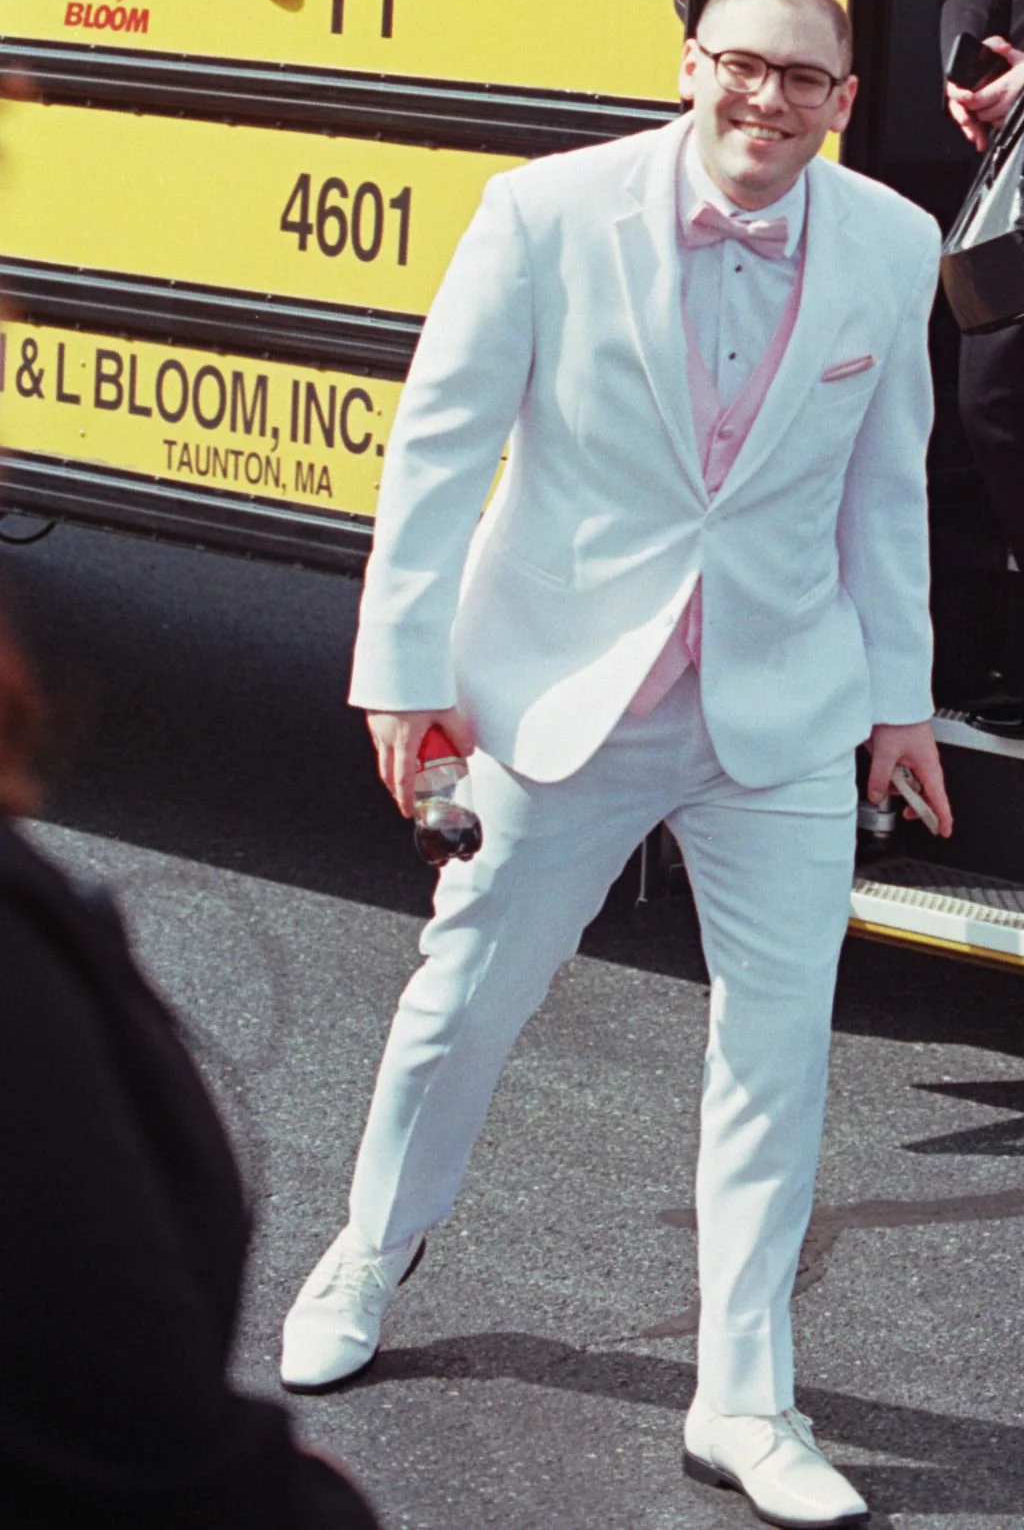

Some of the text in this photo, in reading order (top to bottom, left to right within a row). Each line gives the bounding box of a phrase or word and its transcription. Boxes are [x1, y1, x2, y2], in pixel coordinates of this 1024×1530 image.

[64, 2, 150, 34] BLOOM
[280, 172, 412, 266] 4601
[16, 337, 45, 399] &
[56, 342, 81, 406] L
[94, 347, 281, 453] BLOOM,
[290, 379, 385, 458] INC.
[163, 439, 334, 498] TAUNTON, MA
